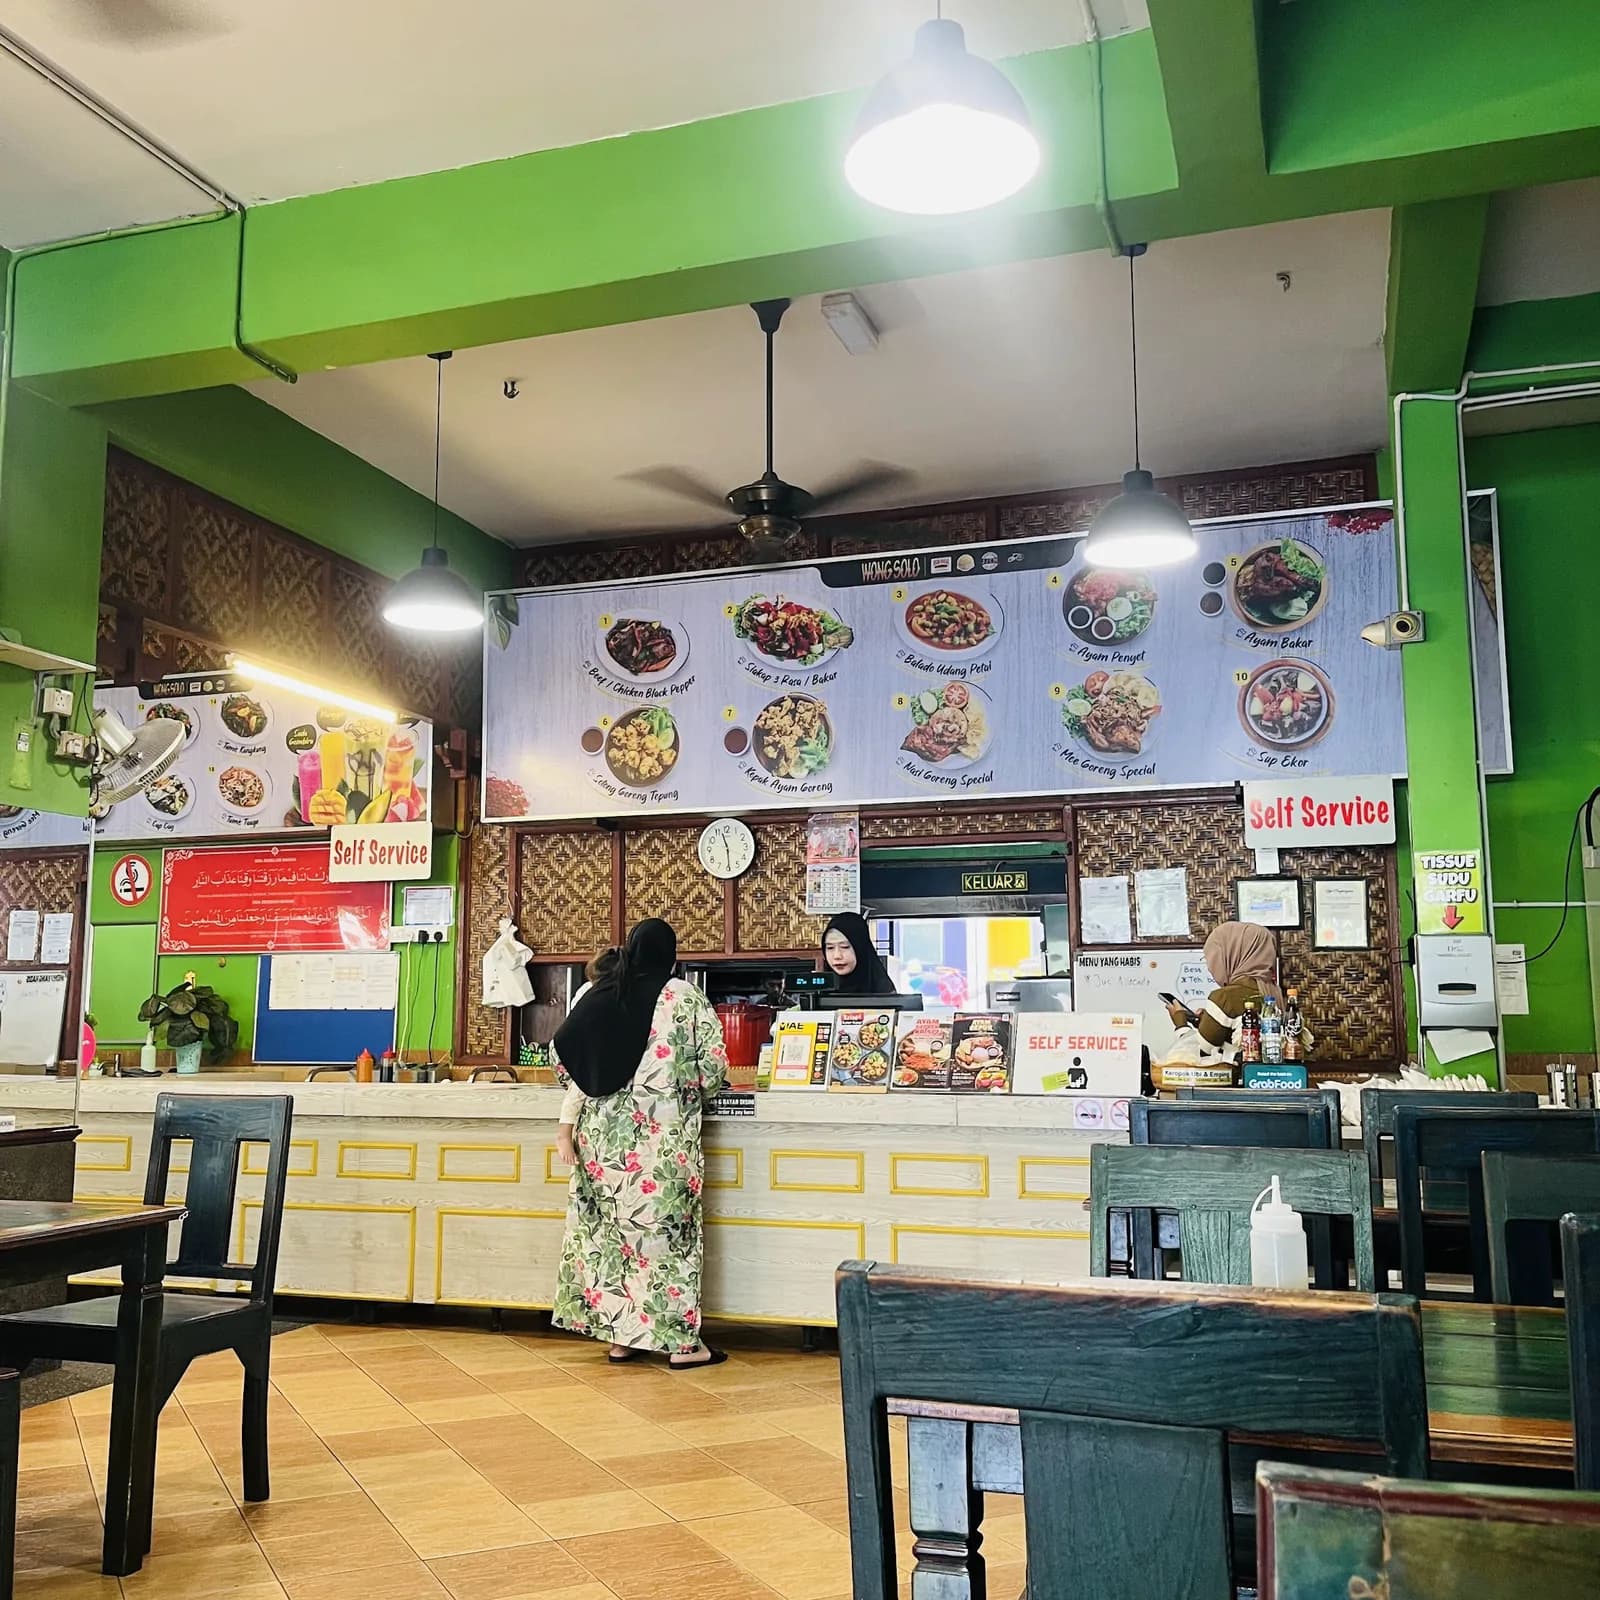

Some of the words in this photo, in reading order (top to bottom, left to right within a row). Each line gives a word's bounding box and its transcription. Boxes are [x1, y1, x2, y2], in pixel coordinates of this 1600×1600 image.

[1231, 558, 1237, 567] 5
[1052, 576, 1058, 584] 4
[896, 590, 902, 599] 3
[727, 606, 733, 614] 2
[1244, 631, 1278, 648] Ayam
[1280, 637, 1313, 649] Bakar
[1077, 646, 1109, 663] Ayam
[1111, 650, 1146, 664] Penyet
[904, 655, 935, 673] Balado
[936, 664, 967, 679] Udang
[969, 661, 993, 675] Petai
[588, 667, 605, 685] Beef
[612, 683, 644, 698] Chicken
[645, 687, 668, 698] Black
[670, 675, 696, 695] Pepper
[781, 676, 801, 687] Rasa
[812, 671, 838, 686] Bakar
[1236, 672, 1247, 681] 10
[1054, 686, 1060, 695] 9
[897, 698, 903, 706] 8
[727, 709, 732, 717] 7
[602, 718, 608, 726] 6
[1060, 749, 1079, 767] Mee
[1080, 759, 1116, 779] Goreng
[1121, 763, 1156, 779] Special
[1257, 751, 1277, 768] Sup
[1280, 754, 1309, 767] Ekor
[744, 766, 768, 786] Kepak
[769, 777, 798, 793] Ayam
[800, 781, 833, 794] Goreng
[904, 762, 923, 779] Nasi
[924, 771, 957, 789] Goreng
[960, 770, 993, 788] Special
[618, 787, 647, 804] Goreng
[650, 789, 679, 804] Tepung
[1249, 796, 1294, 829] Self
[1301, 795, 1389, 828] Service
[334, 839, 365, 865] Self
[368, 840, 428, 865] Service
[1420, 854, 1477, 870] TISSUE
[964, 874, 1013, 890] KELUAR
[1426, 871, 1471, 886] SUDU
[1422, 888, 1478, 903] GARFU
[1079, 957, 1099, 967] MENU
[1100, 957, 1119, 967] YANG
[1120, 956, 1141, 967] HABIS
[1029, 1036, 1063, 1050] SELF
[1068, 1036, 1128, 1050] SERVICE
[1248, 1078, 1302, 1089] GrabFood
